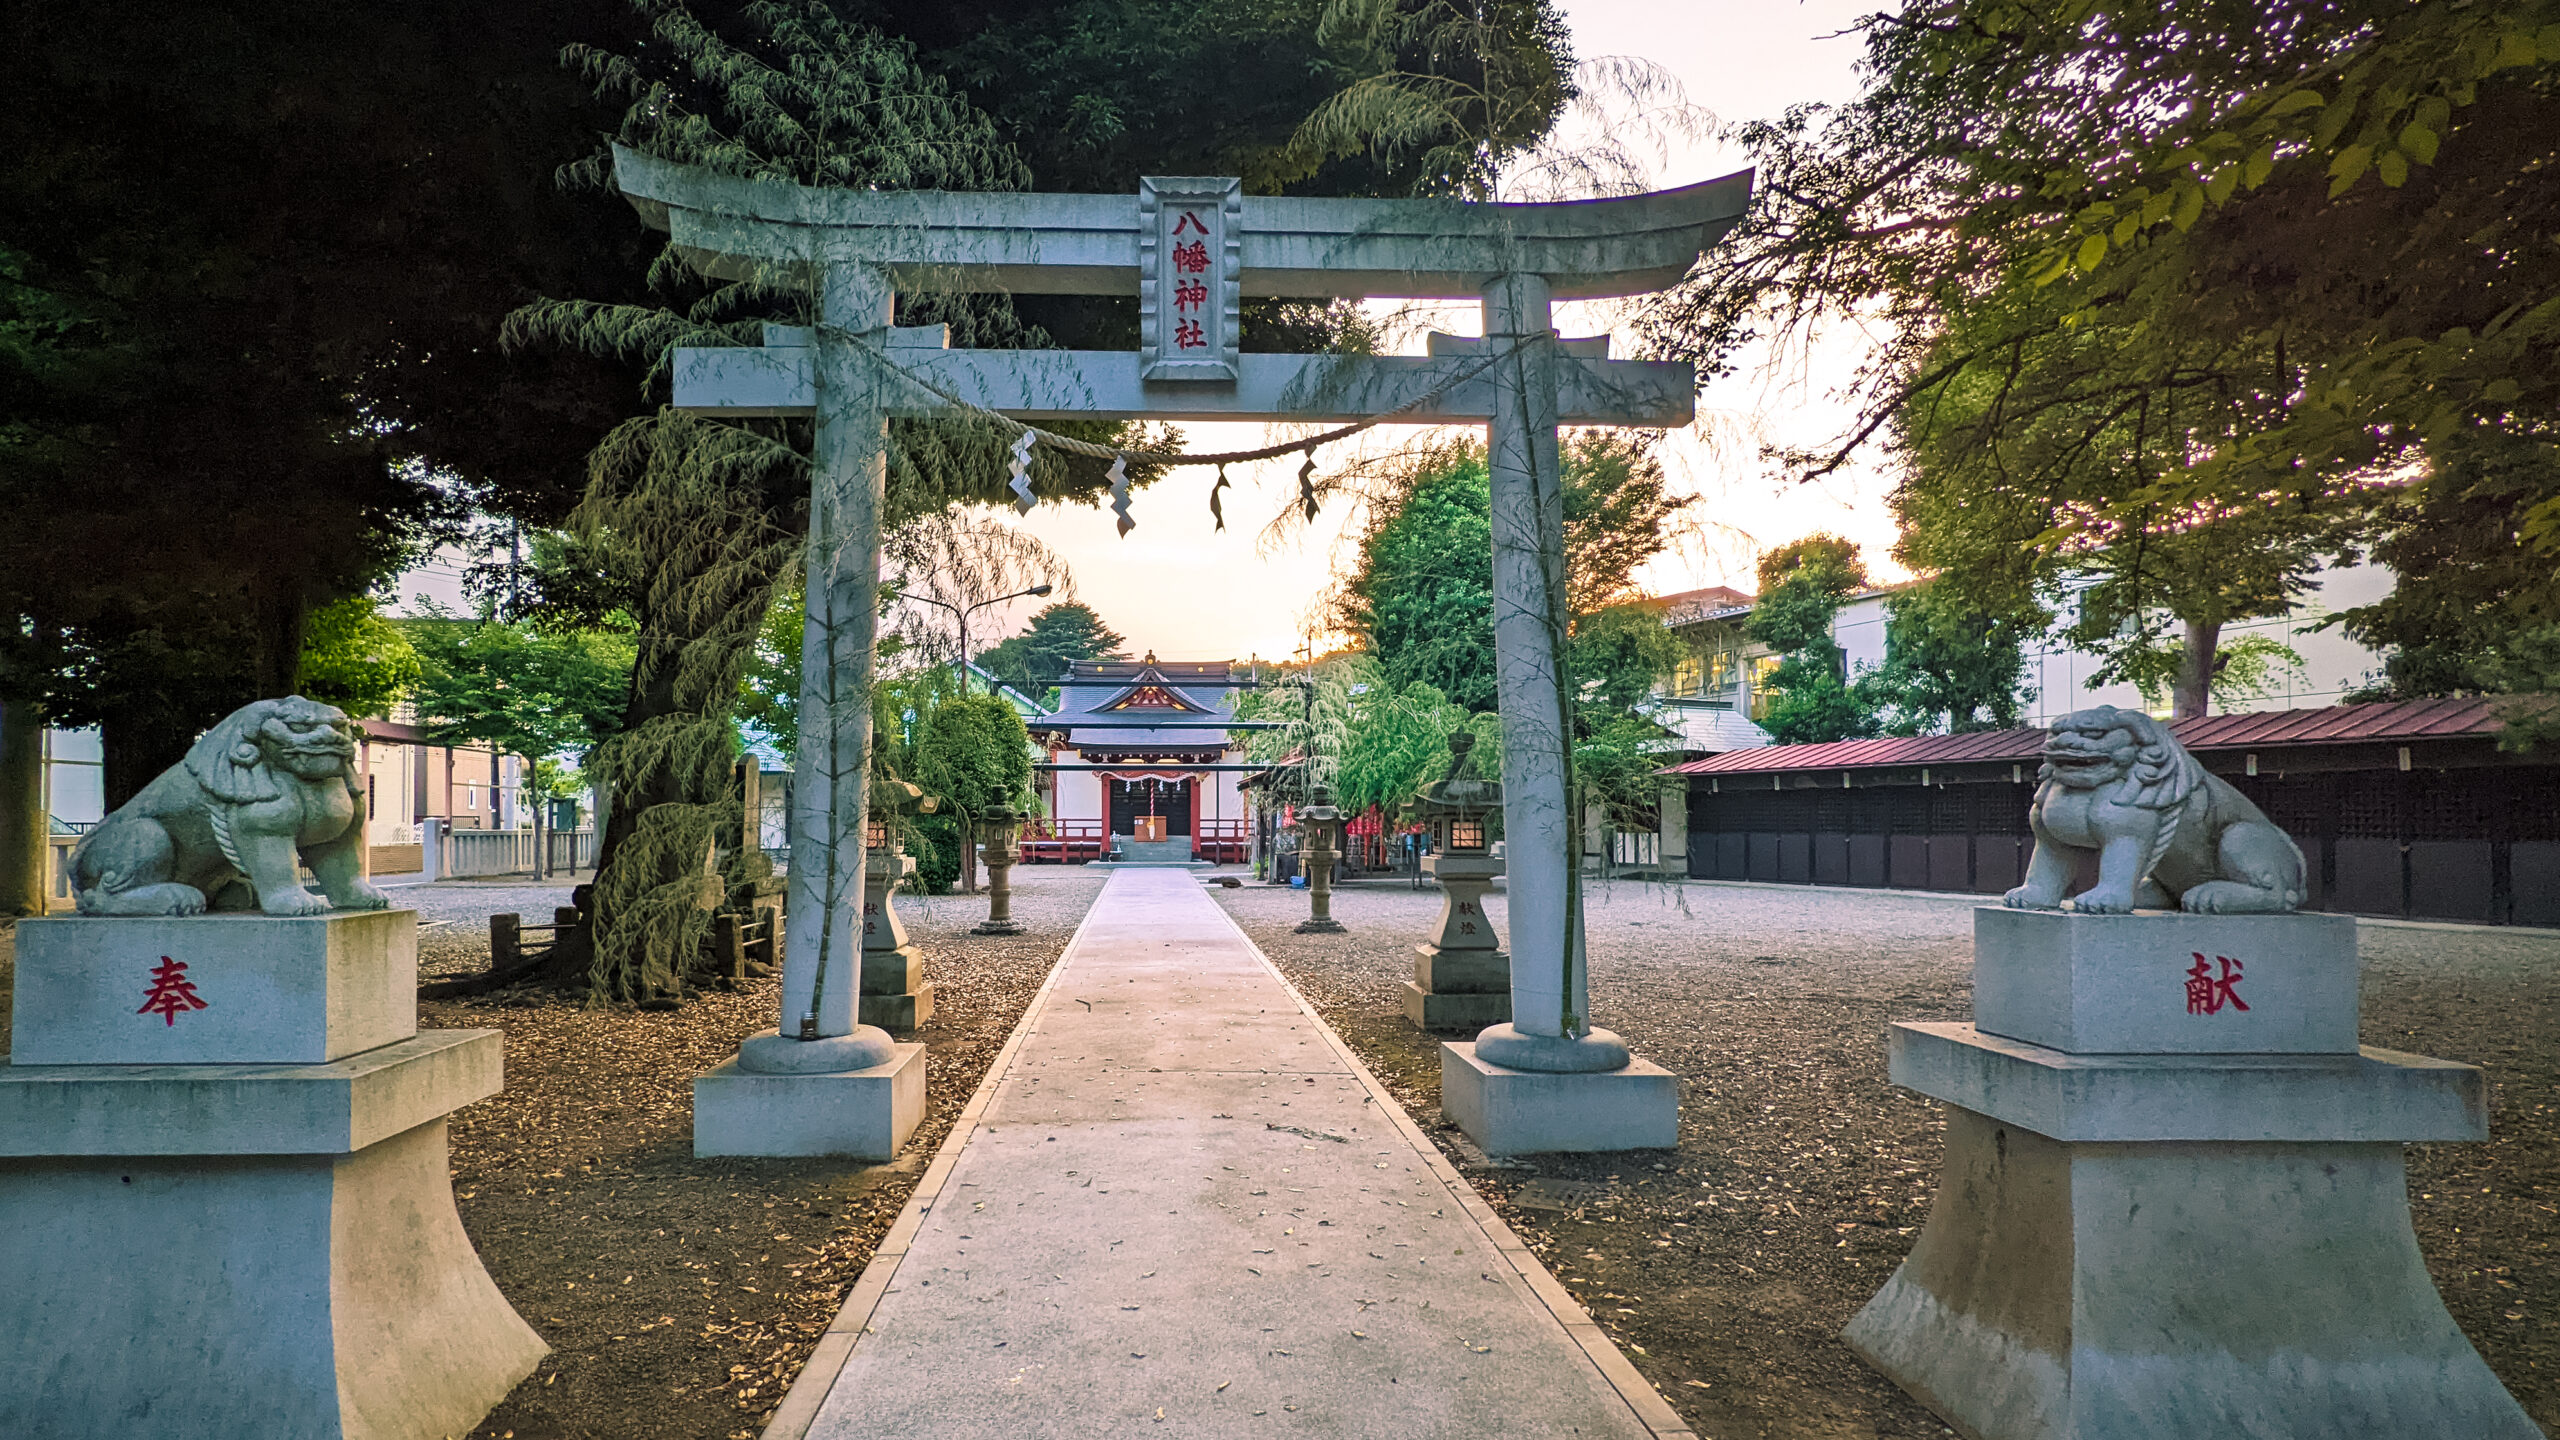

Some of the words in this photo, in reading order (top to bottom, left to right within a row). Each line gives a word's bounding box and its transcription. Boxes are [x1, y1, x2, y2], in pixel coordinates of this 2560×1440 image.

[1172, 211, 1212, 350] 八幡神社
[136, 955, 209, 1027] 奉
[2184, 952, 2250, 1016] 献
